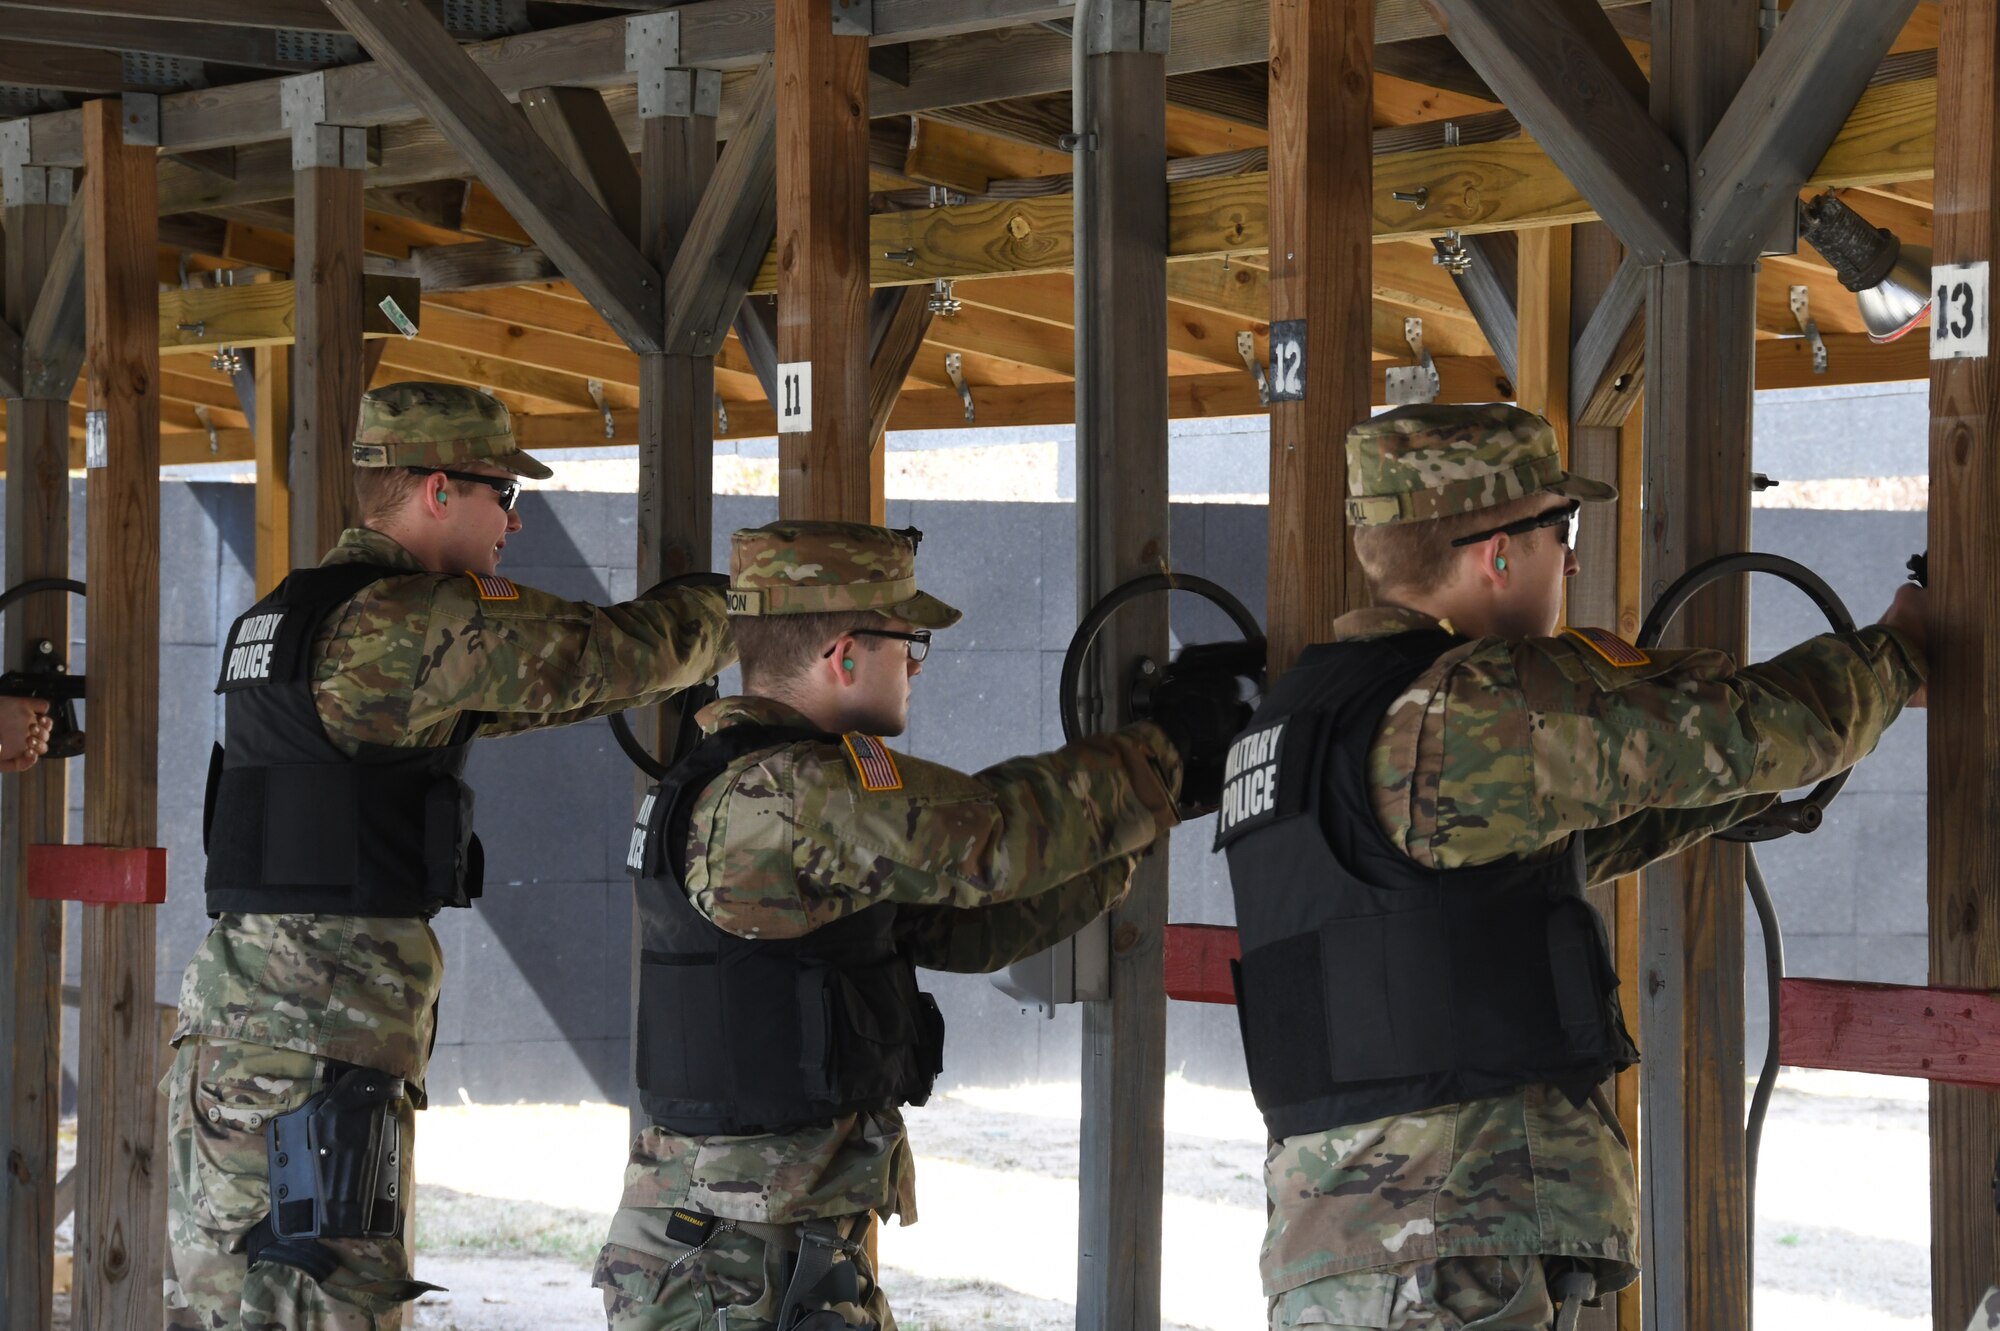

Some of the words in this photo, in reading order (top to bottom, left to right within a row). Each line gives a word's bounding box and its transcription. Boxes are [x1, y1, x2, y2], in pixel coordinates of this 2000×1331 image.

[1937, 282, 1974, 340] 13
[1276, 341, 1302, 394] 12
[785, 375, 800, 416] 11
[235, 614, 284, 645] MILITARY
[226, 643, 274, 681] POLICE
[1221, 764, 1277, 833] POLICE
